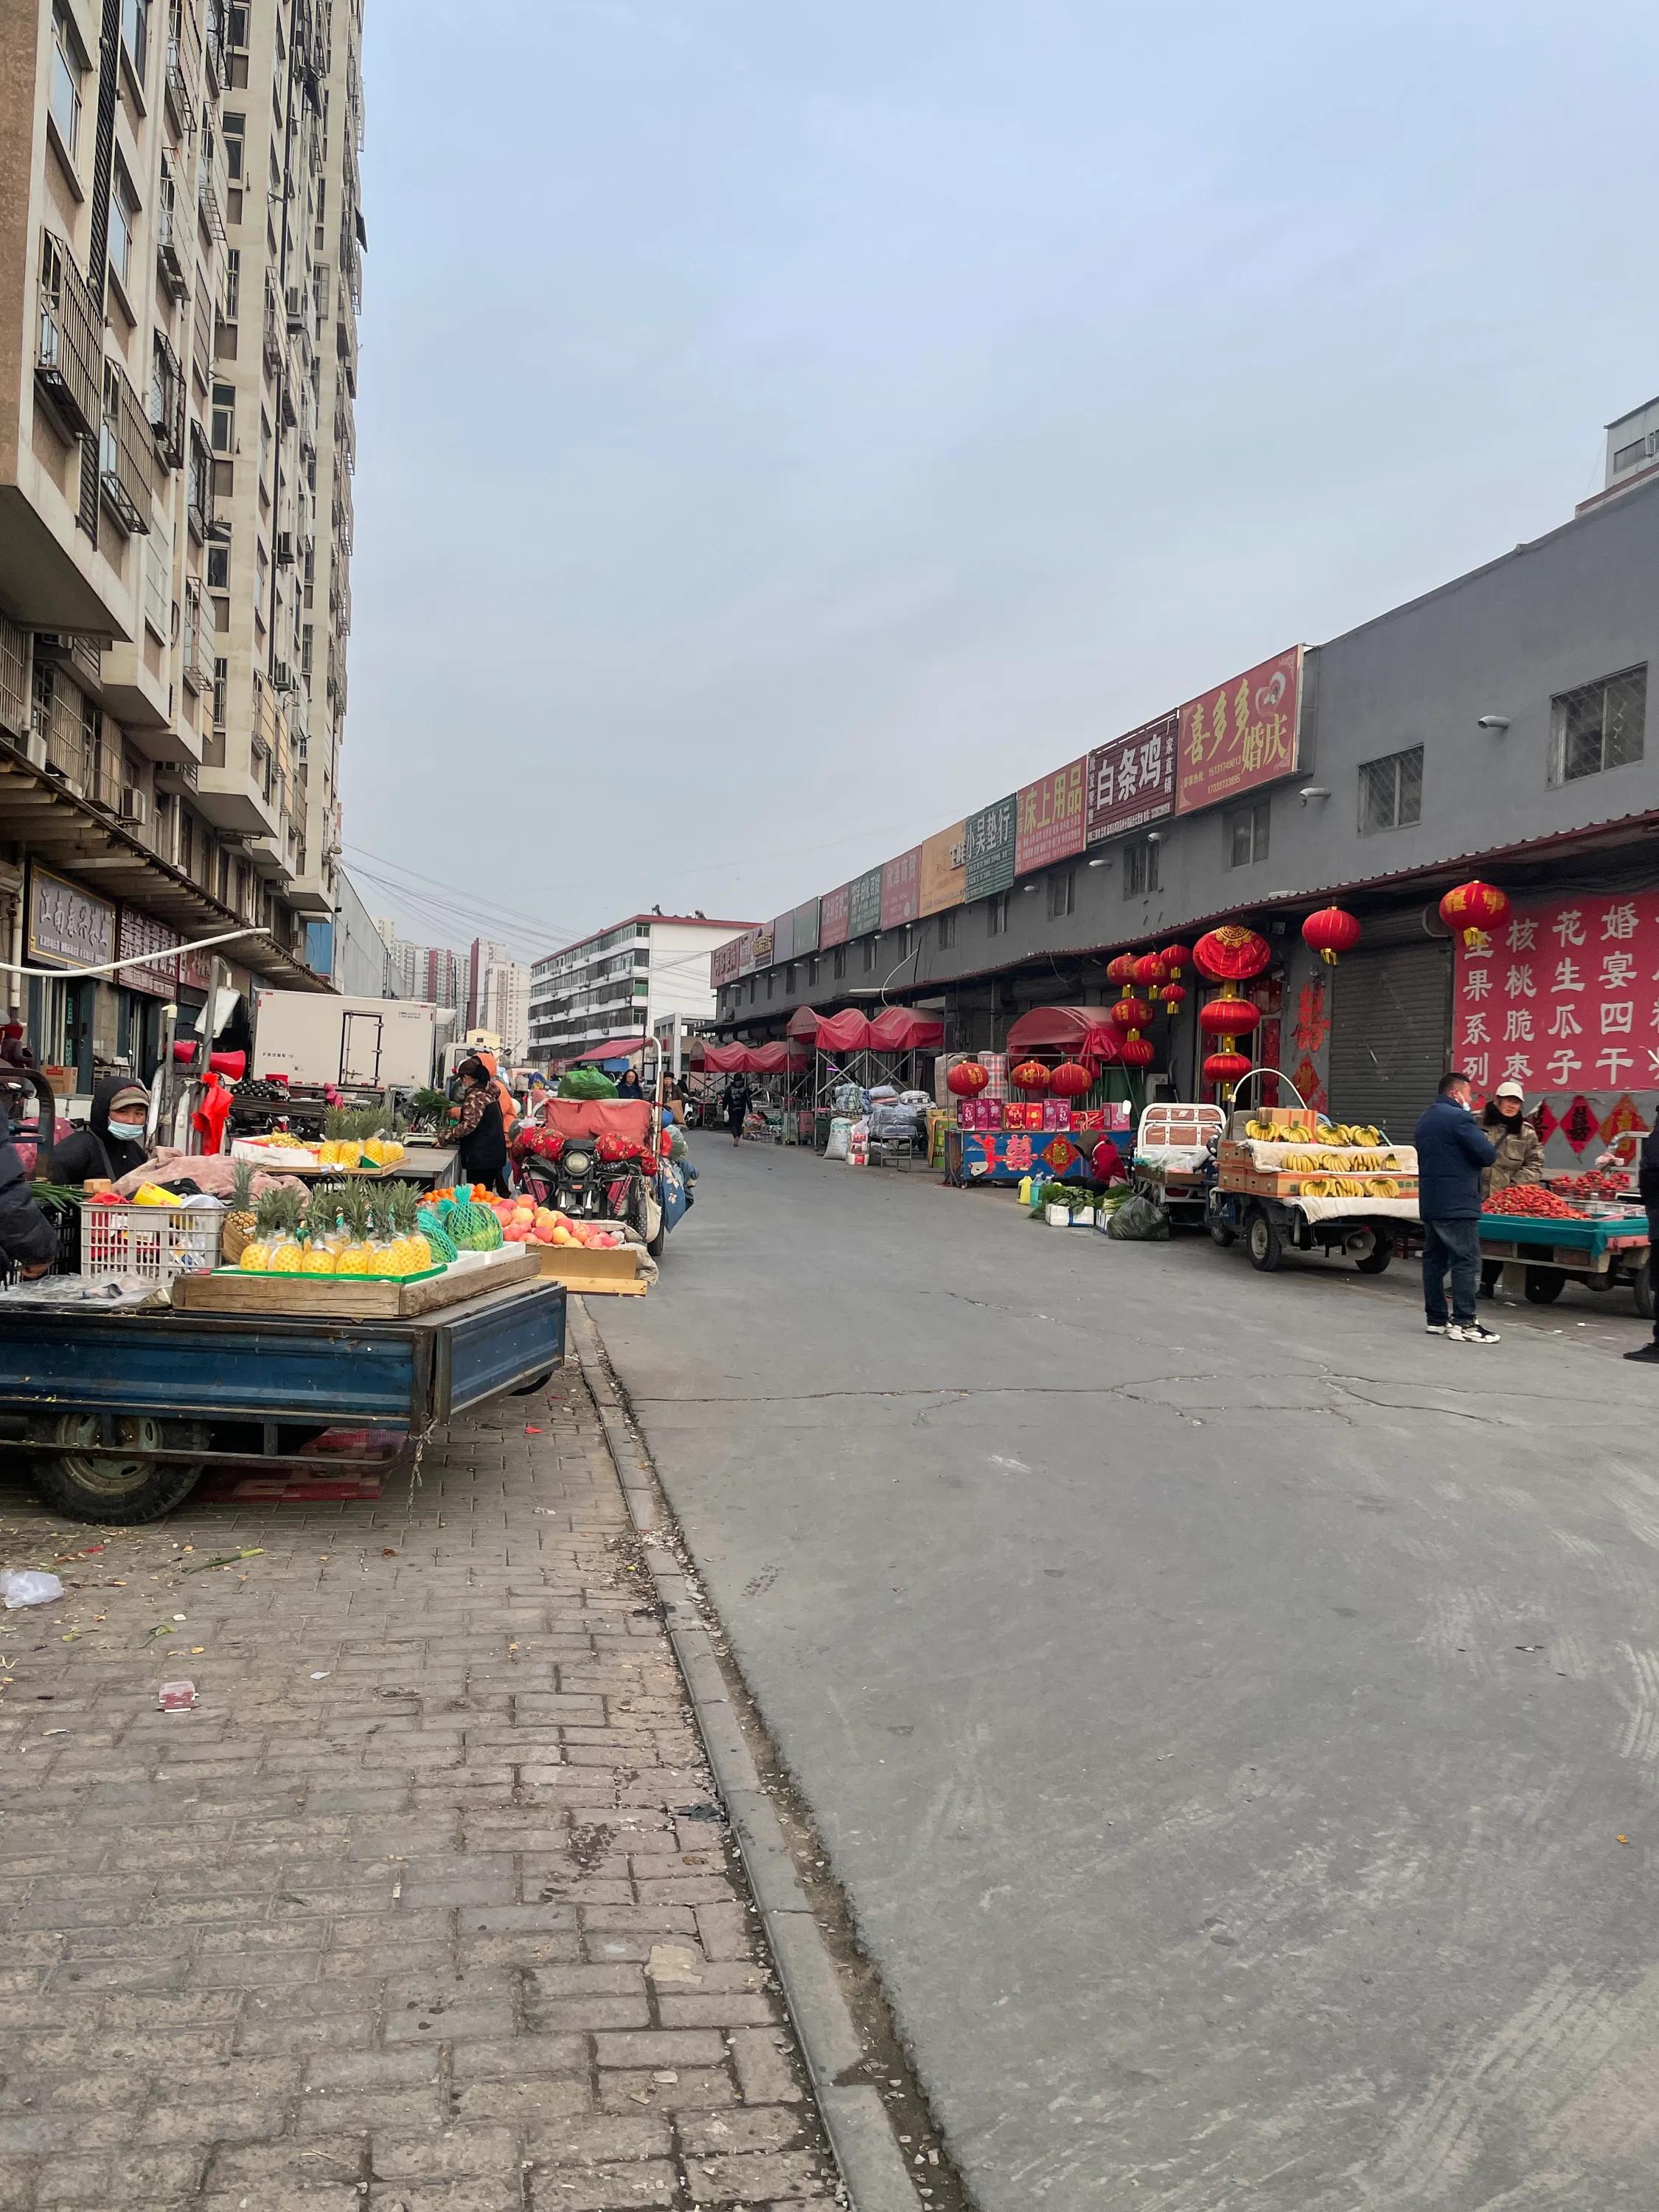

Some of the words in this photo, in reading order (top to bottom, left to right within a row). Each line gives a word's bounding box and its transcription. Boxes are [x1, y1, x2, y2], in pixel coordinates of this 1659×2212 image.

[1184, 678, 1250, 765] 喜多多
[1241, 714, 1287, 774] 婚庆
[1024, 764, 1082, 835] 床上用品
[1096, 734, 1161, 810] 白条鸡
[1501, 919, 1539, 1086] 核桃脆枣
[1546, 910, 1586, 1085] 花生瓜子
[1596, 902, 1639, 1085] 婚宴四干
